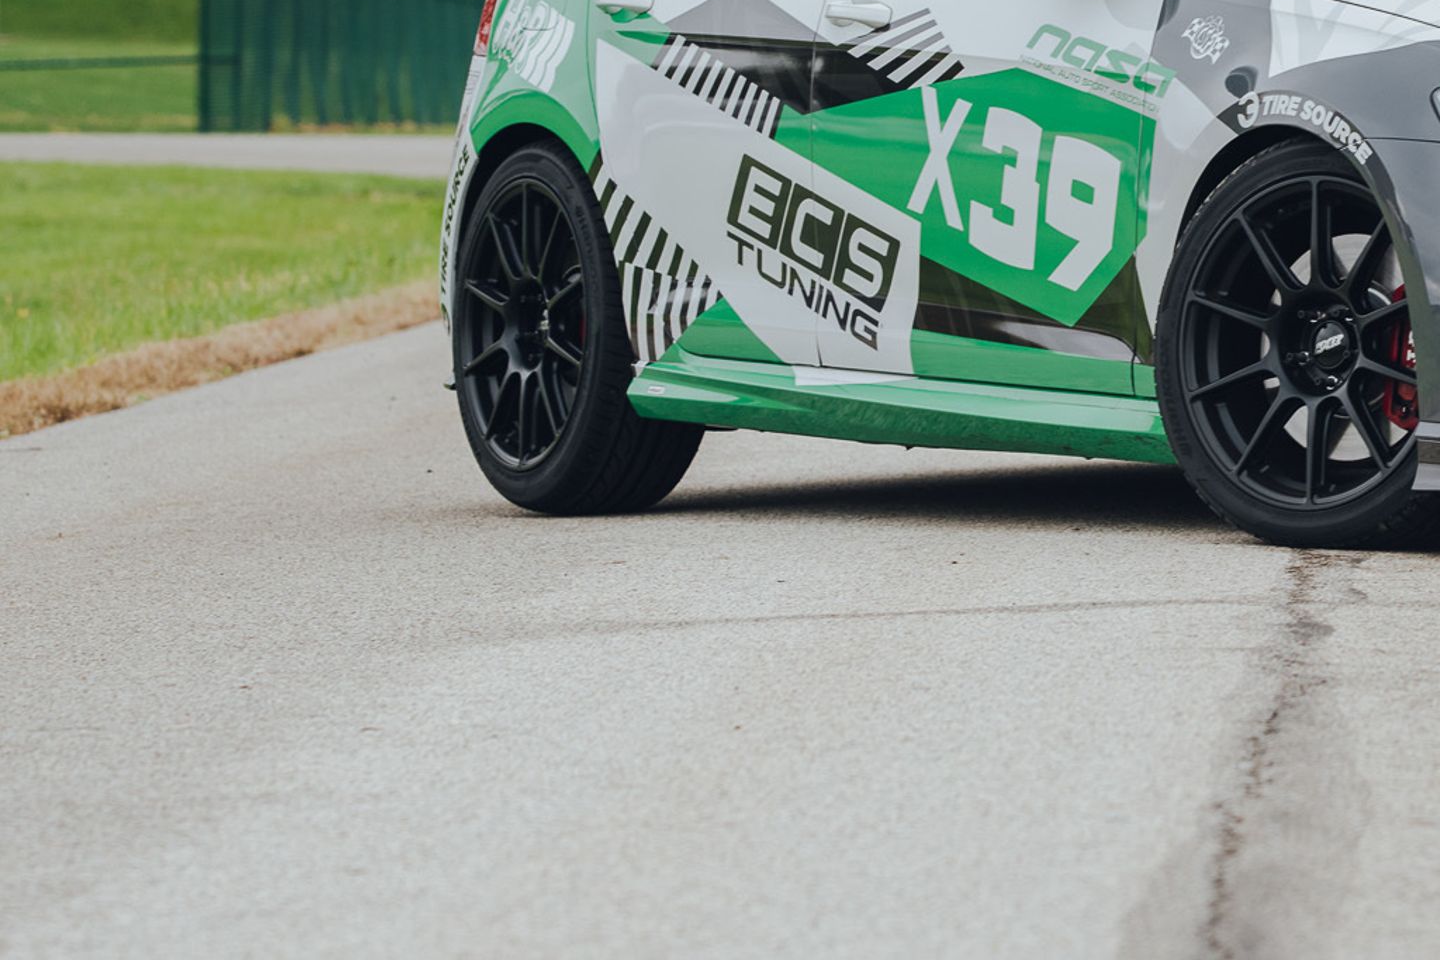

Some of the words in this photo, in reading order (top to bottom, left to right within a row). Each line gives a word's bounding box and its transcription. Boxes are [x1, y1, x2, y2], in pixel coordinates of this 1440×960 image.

[444, 143, 470, 238] SOURCE
[906, 83, 1123, 292] X39
[1261, 93, 1303, 117] TIRE
[1299, 99, 1374, 166] SOURCE
[726, 230, 879, 352] TUNING
[728, 154, 900, 312] ECS
